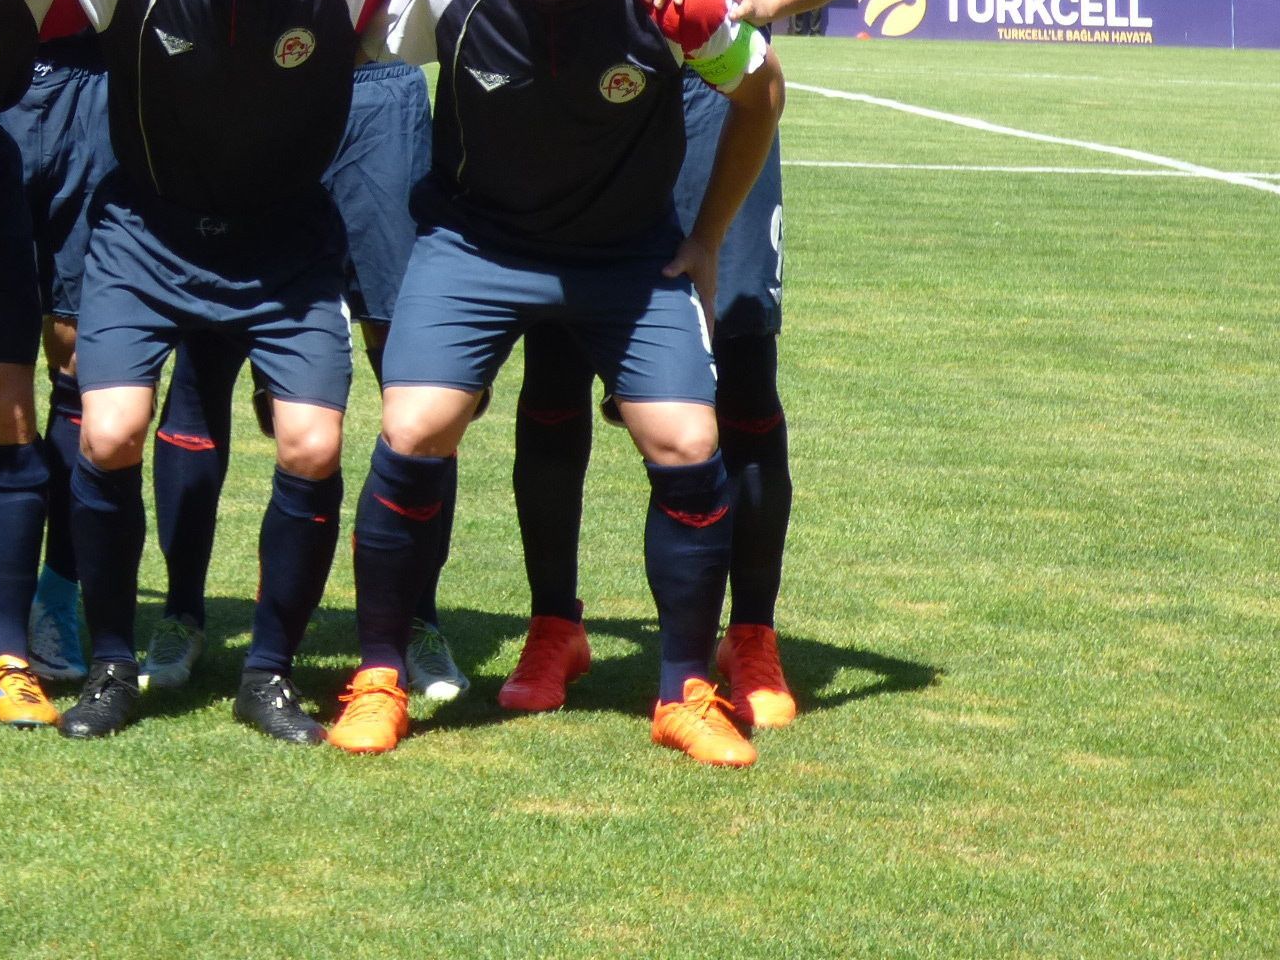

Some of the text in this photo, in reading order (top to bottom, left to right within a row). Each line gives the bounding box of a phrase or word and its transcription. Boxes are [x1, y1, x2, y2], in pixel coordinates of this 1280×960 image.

[997, 27, 1153, 44] TURKCELL'LE BAĞLAN HAYATA
